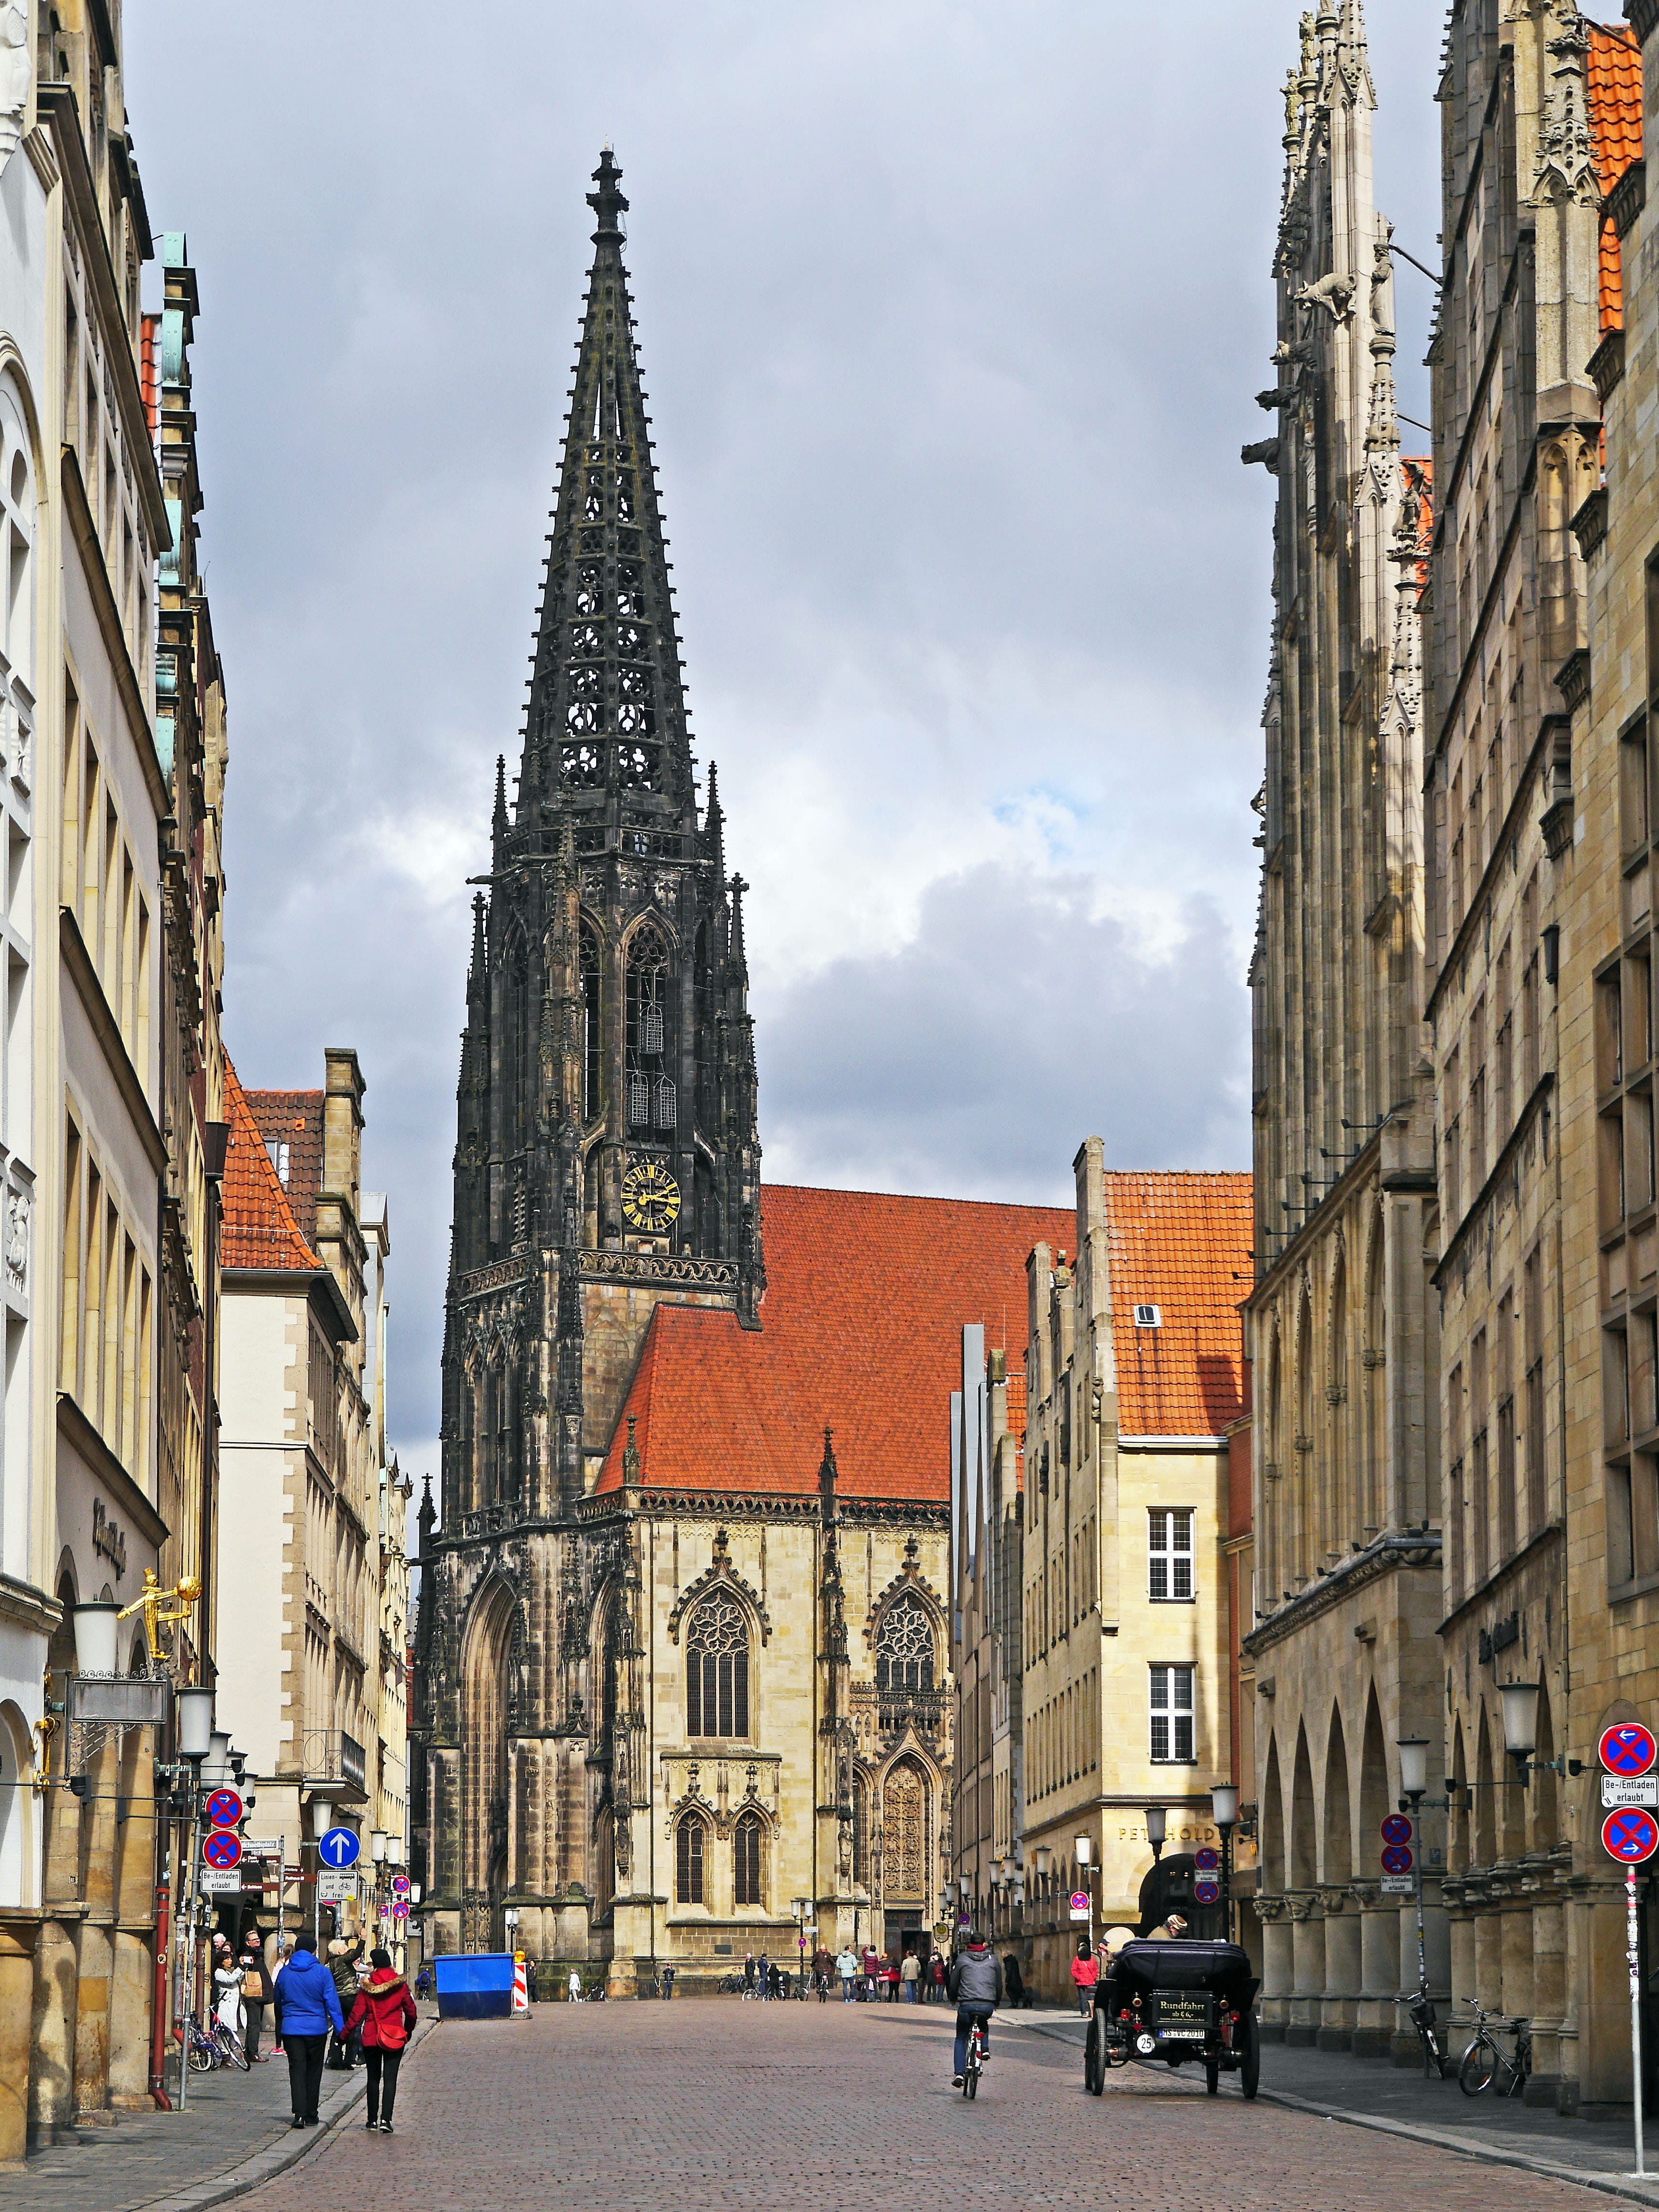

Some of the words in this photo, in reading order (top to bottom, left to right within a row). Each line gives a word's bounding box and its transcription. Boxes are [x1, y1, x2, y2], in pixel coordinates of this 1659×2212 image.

[1606, 1780, 1655, 1789] Be-/Entladen
[1617, 1793, 1644, 1802] erlaubt
[1119, 1828, 1214, 1840] PETHOLD
[1160, 2001, 1205, 2010] Rundfahrt
[1142, 2038, 1151, 2049] 25
